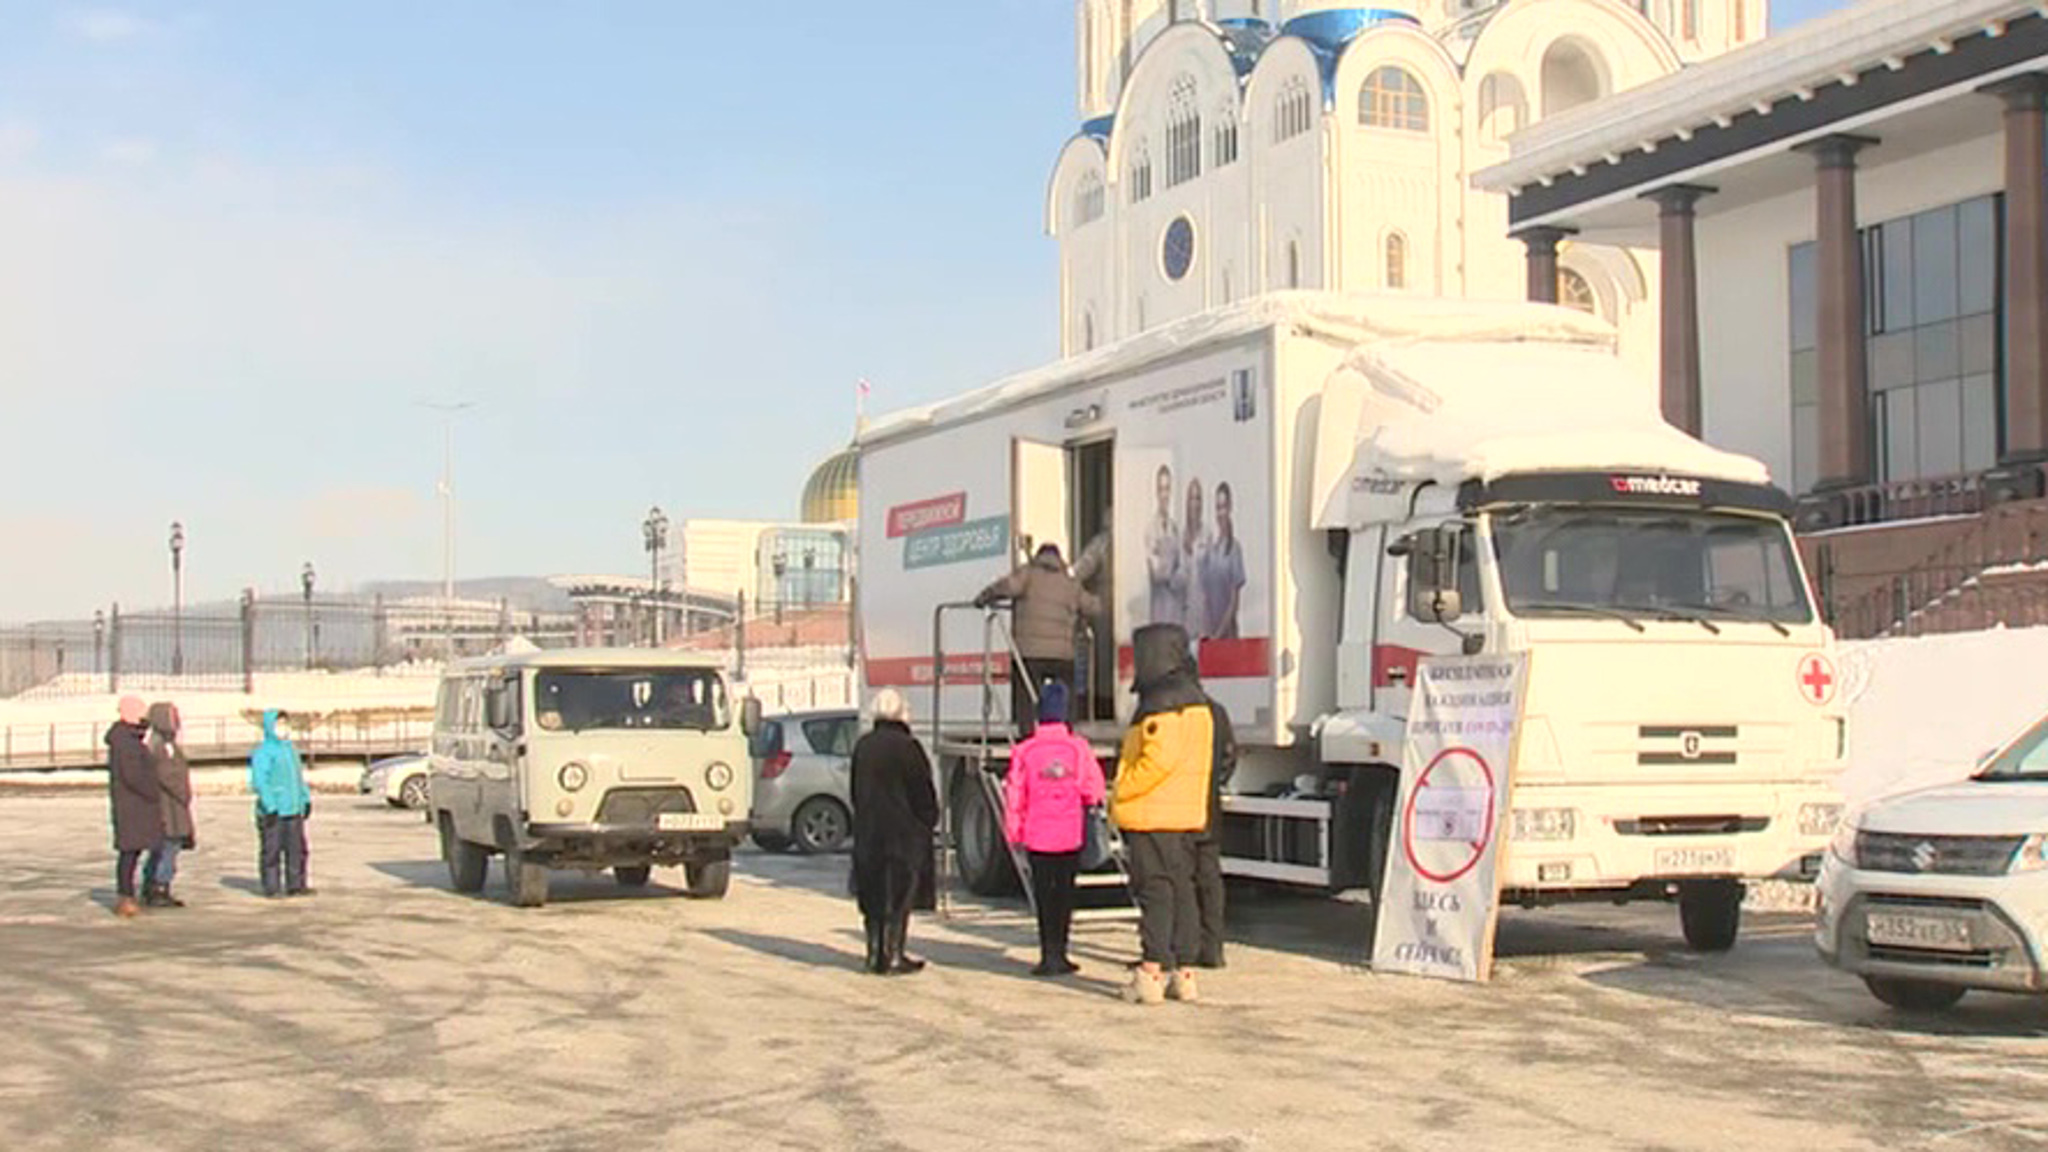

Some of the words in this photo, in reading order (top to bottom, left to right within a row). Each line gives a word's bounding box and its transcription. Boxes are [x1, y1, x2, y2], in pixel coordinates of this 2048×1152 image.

[1627, 473, 1701, 495] medcar
[907, 534, 942, 562] ЦЕНТР
[942, 523, 1001, 558] ЗДОРОВЬЯ
[1411, 890, 1461, 912] ЗДЕСЬ
[1425, 918, 1438, 937] И
